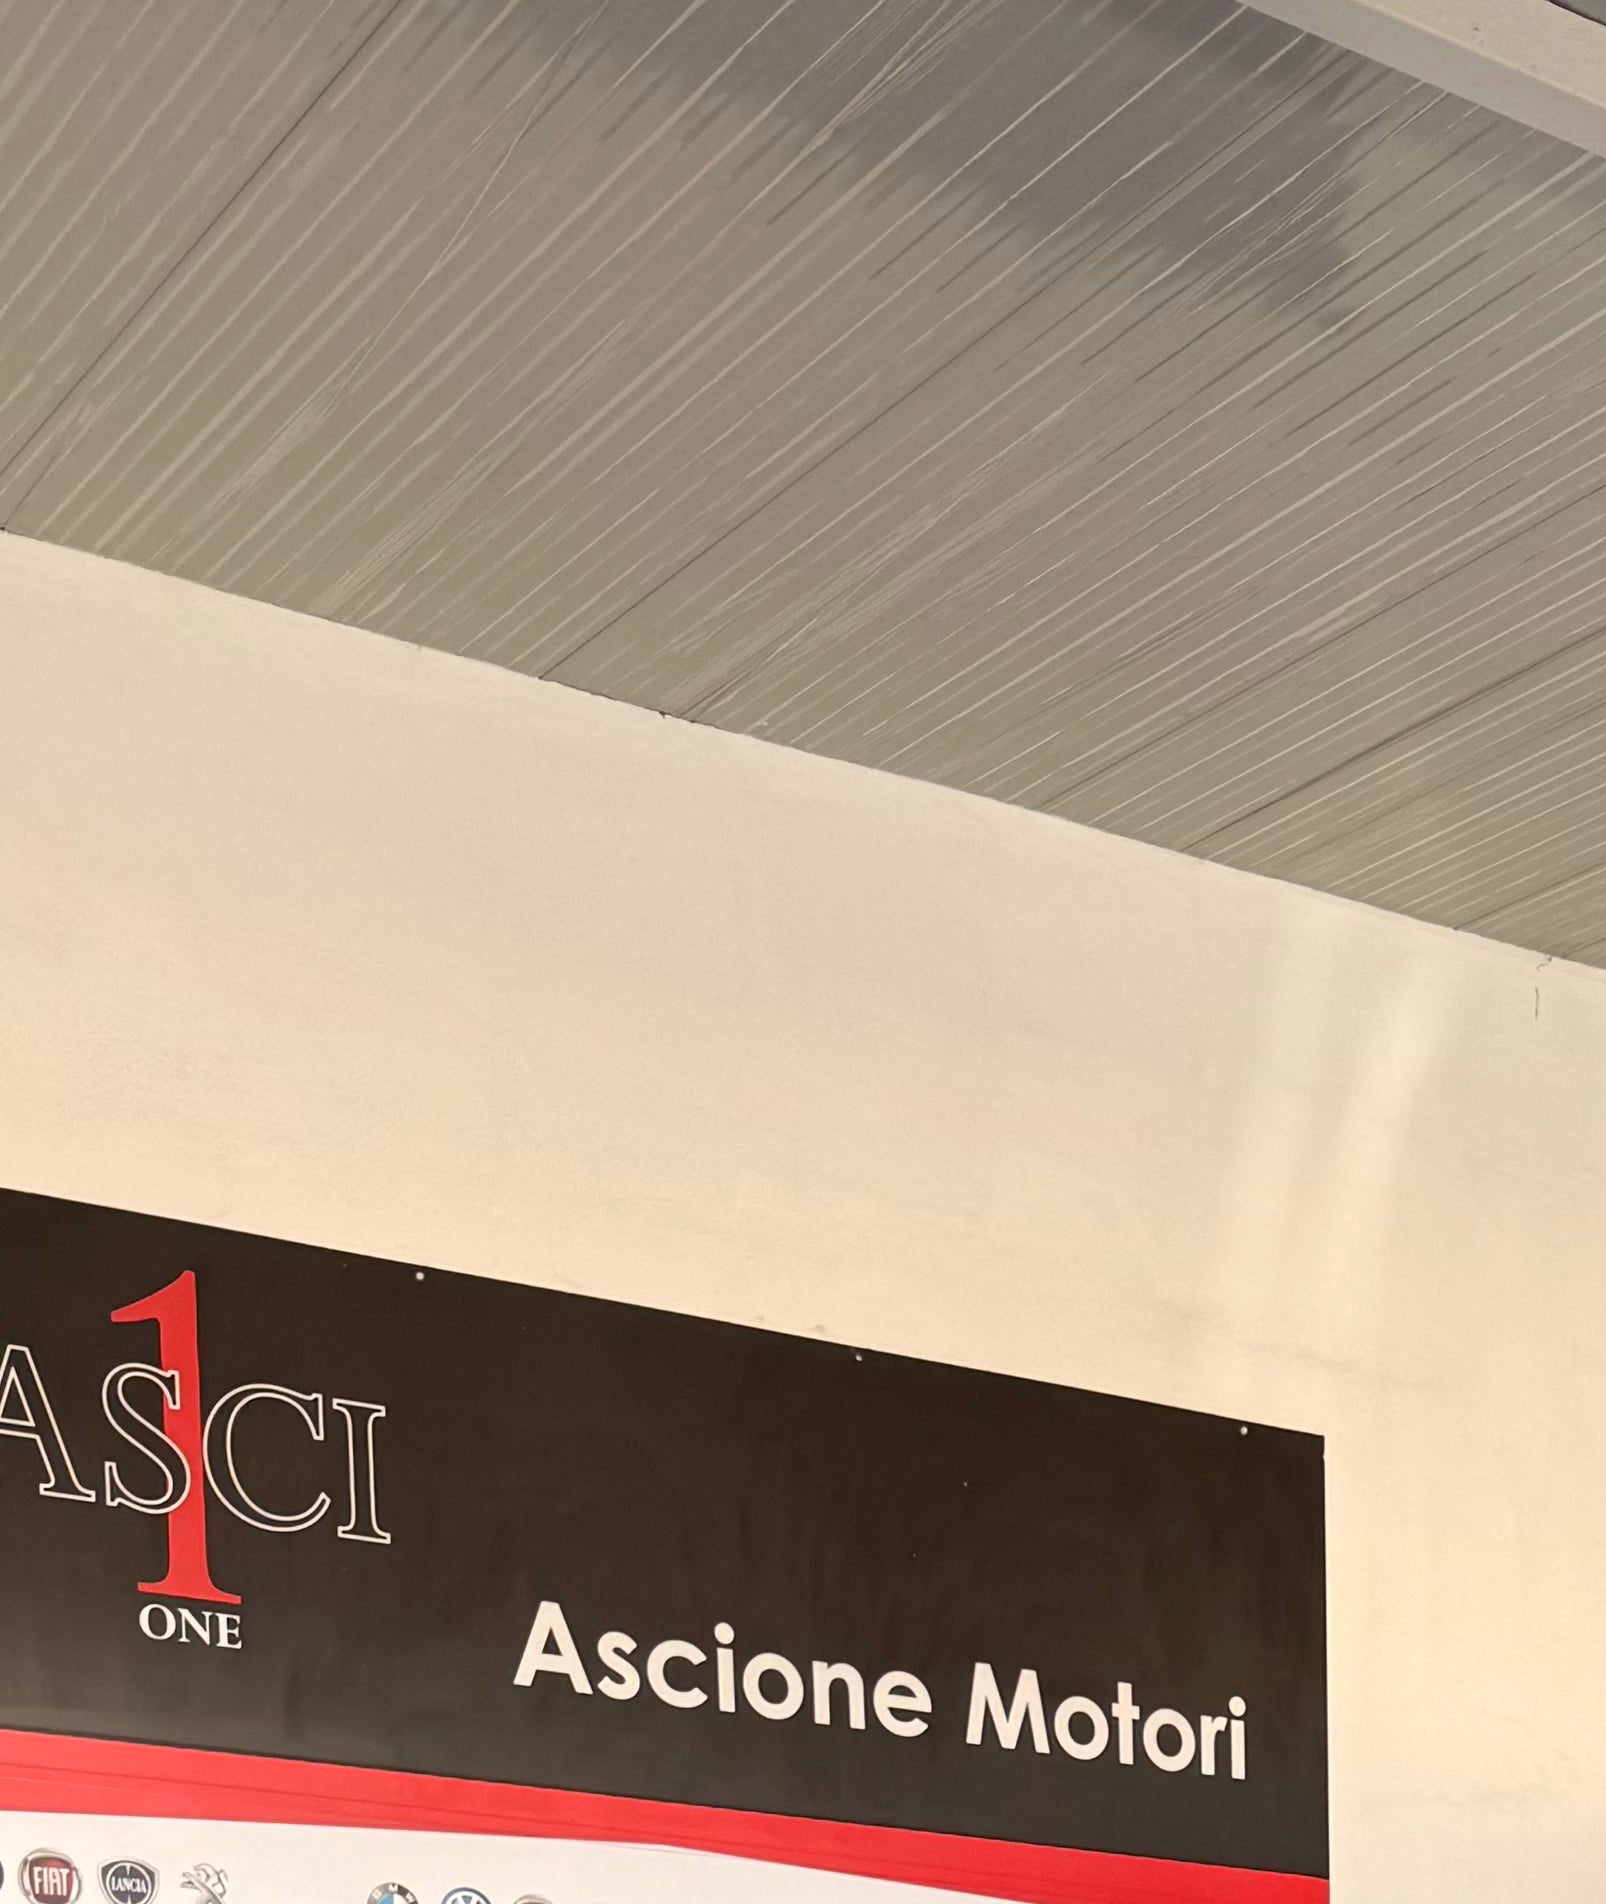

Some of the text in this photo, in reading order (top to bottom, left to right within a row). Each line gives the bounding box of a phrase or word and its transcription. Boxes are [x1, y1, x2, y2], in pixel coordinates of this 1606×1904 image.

[139, 1603, 242, 1650] ONE
[513, 1600, 1247, 1780] Ascione Motori
[33, 1866, 70, 1897] FIAT
[111, 1876, 148, 1895] LANCIA
